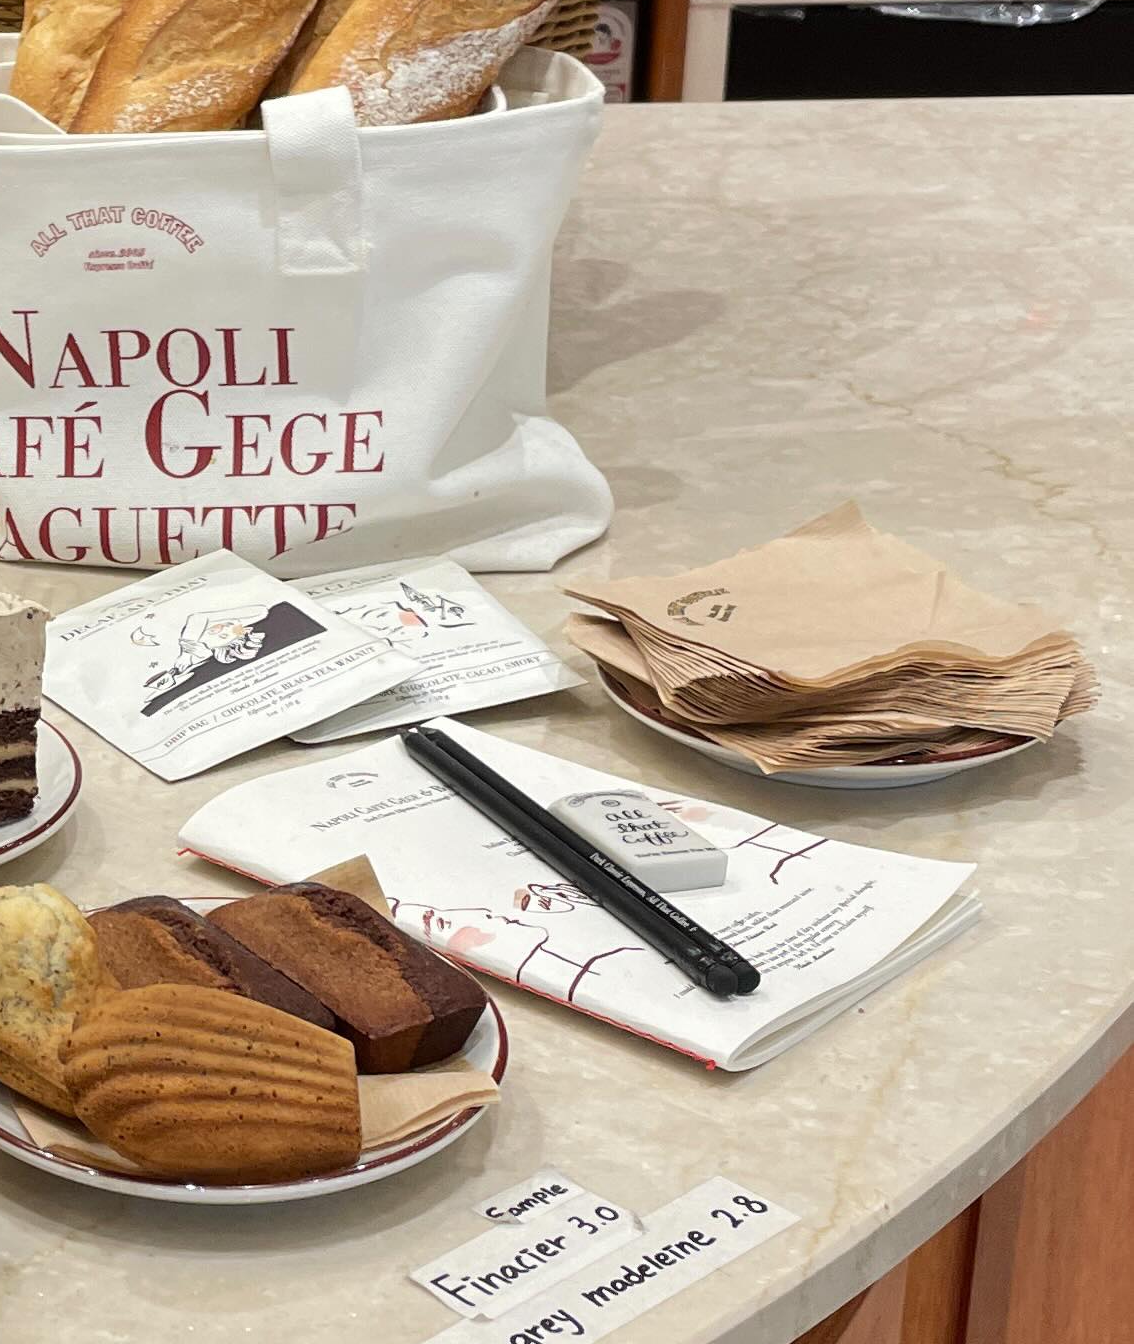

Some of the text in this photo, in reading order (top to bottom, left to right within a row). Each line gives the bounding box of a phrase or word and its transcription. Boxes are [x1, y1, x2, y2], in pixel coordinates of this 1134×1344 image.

[31, 205, 205, 257] ALL THAT COFFEE
[144, 389, 385, 479] GEGE
[164, 729, 188, 748] DRIP
[188, 719, 209, 732] BAG
[280, 674, 314, 691] BLACK
[334, 646, 376, 667] WALNUT
[505, 655, 542, 670] SMOKY
[430, 1206, 619, 1307] Finacier 3.0
[581, 1229, 717, 1307] madeleine
[711, 1195, 768, 1229] 2.8
